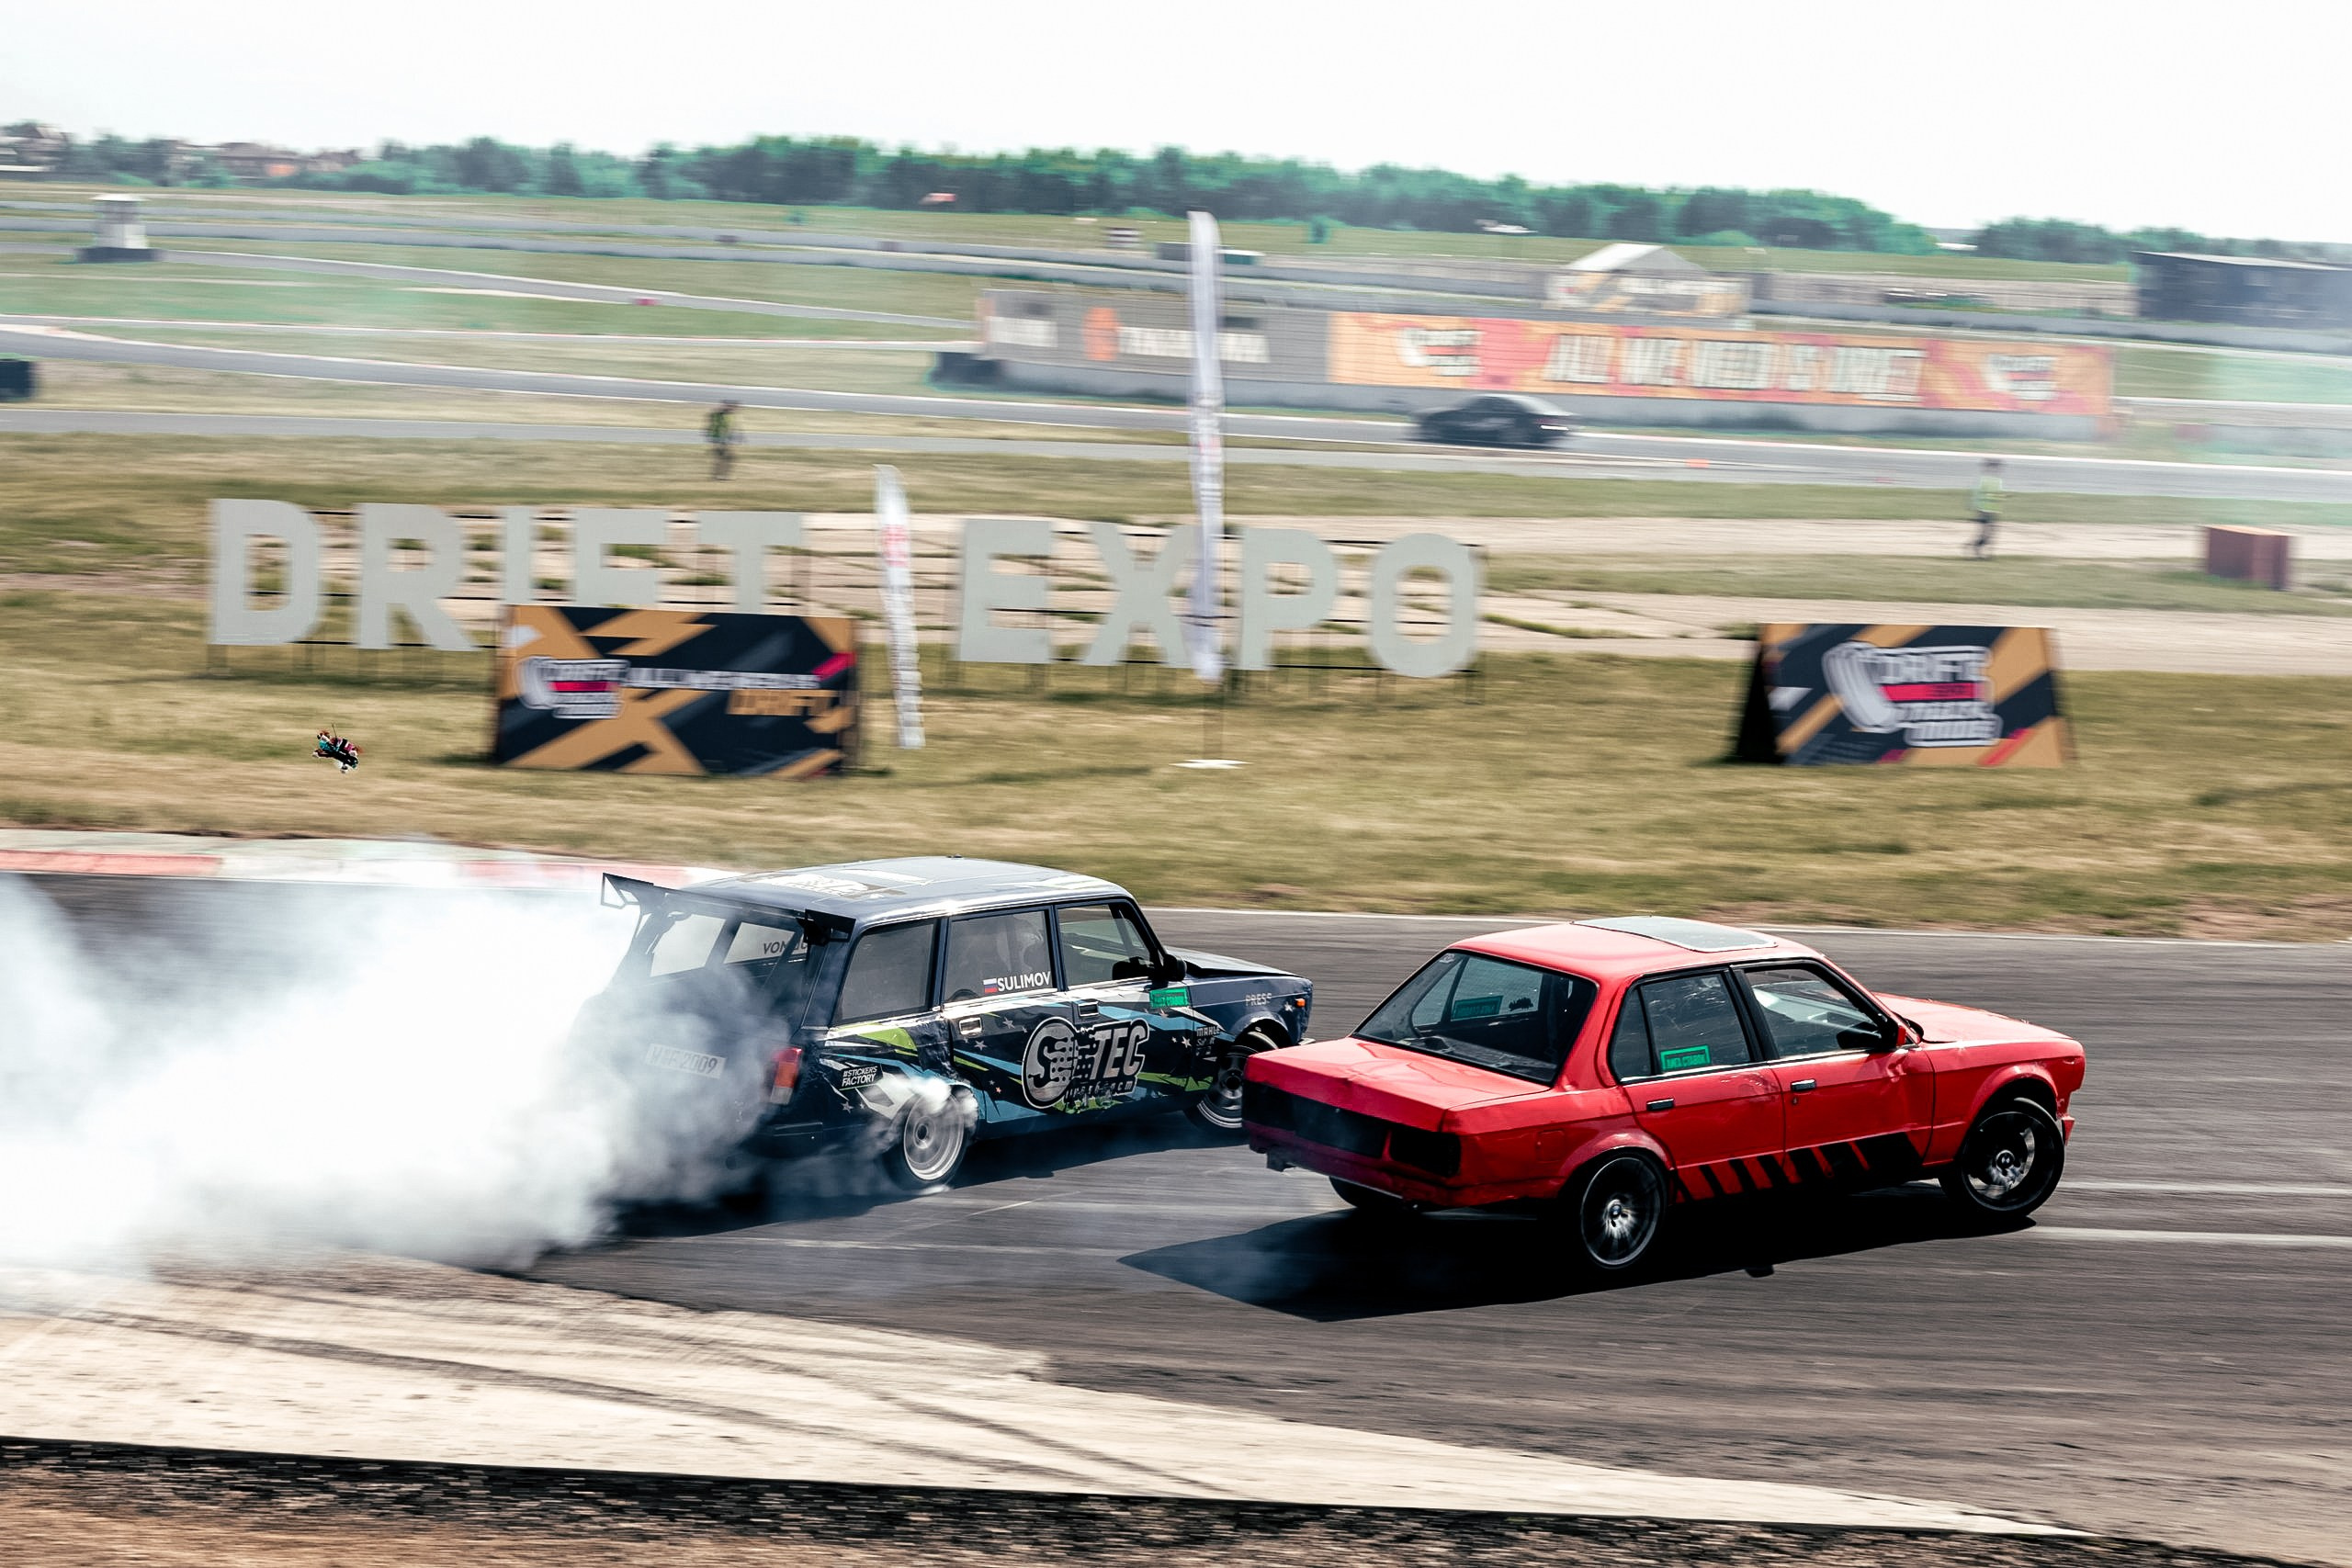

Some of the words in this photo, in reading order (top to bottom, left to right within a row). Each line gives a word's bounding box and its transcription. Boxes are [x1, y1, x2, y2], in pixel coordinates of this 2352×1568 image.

[206, 499, 806, 650] DRIFT
[958, 518, 1479, 678] EXPO
[997, 970, 1051, 992] SULIMOV
[1245, 992, 1272, 1006] PRESS
[842, 1066, 878, 1078] #STICKERS
[842, 1073, 876, 1088] FACTORY
